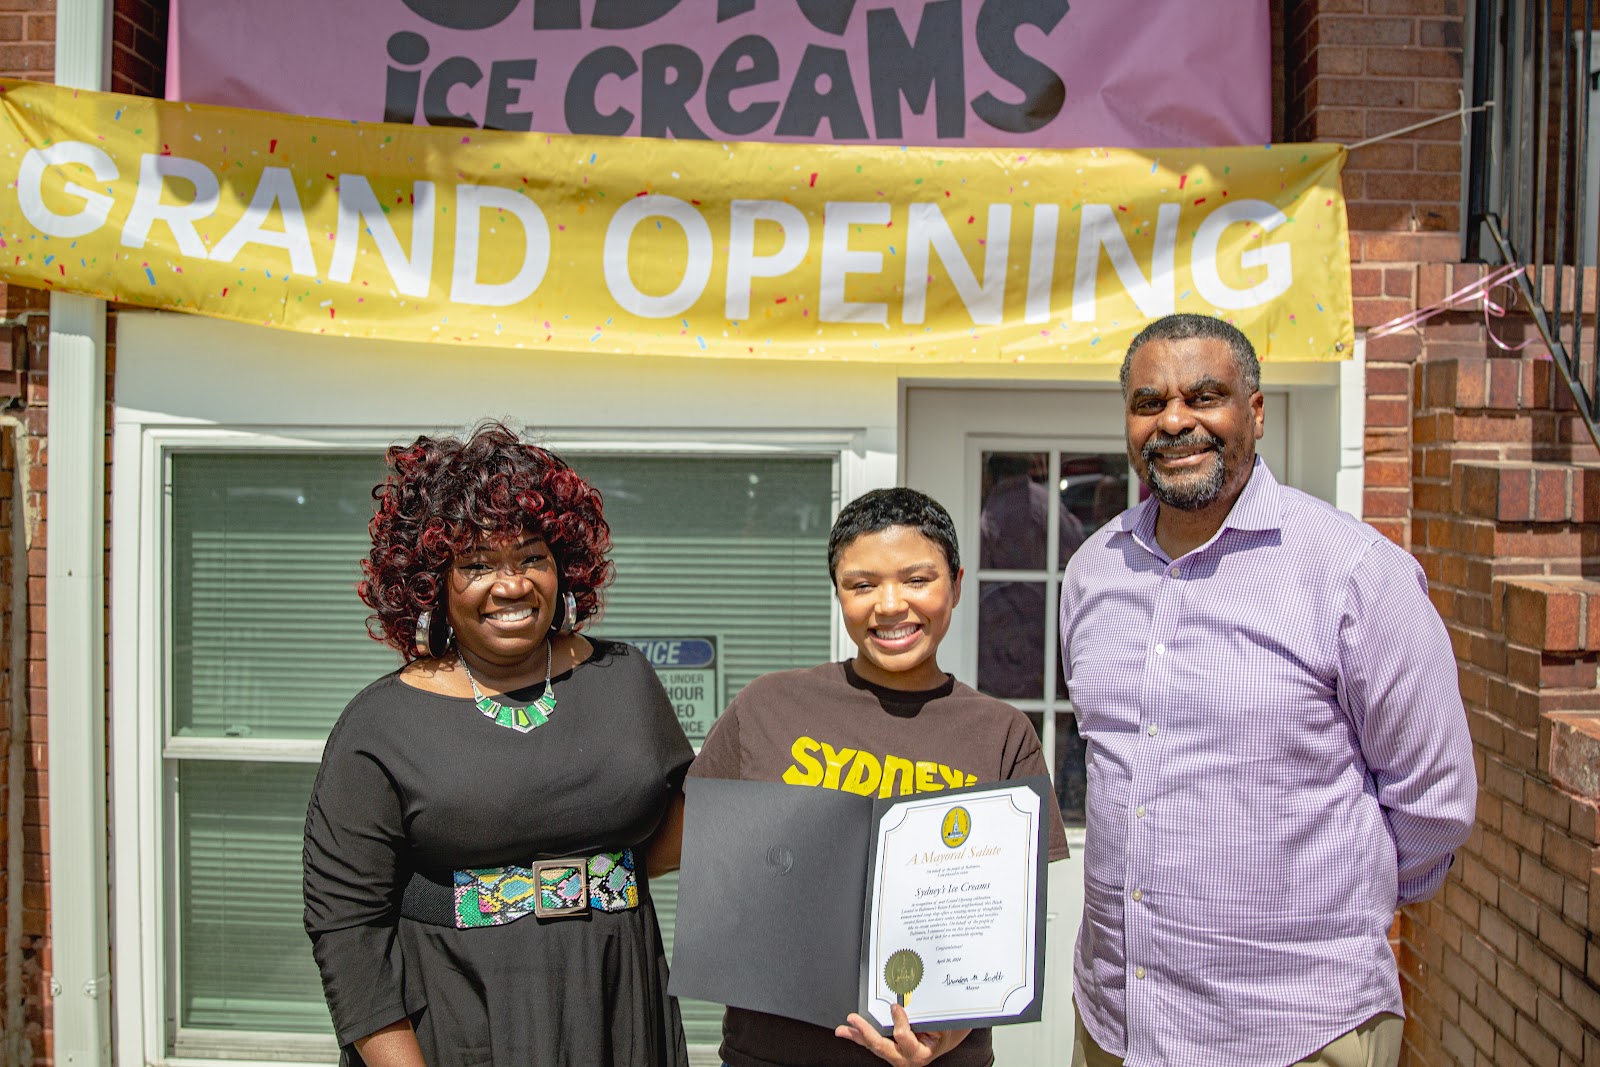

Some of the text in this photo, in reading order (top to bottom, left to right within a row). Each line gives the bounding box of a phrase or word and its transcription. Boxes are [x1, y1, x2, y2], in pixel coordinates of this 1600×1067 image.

[18, 140, 1293, 324] GRAND OPENING
[631, 641, 682, 664] TICE
[669, 674, 704, 684] UNDER
[905, 844, 1002, 866] A Mayoral Salute
[914, 882, 991, 899] Sydney's Ice Creams
